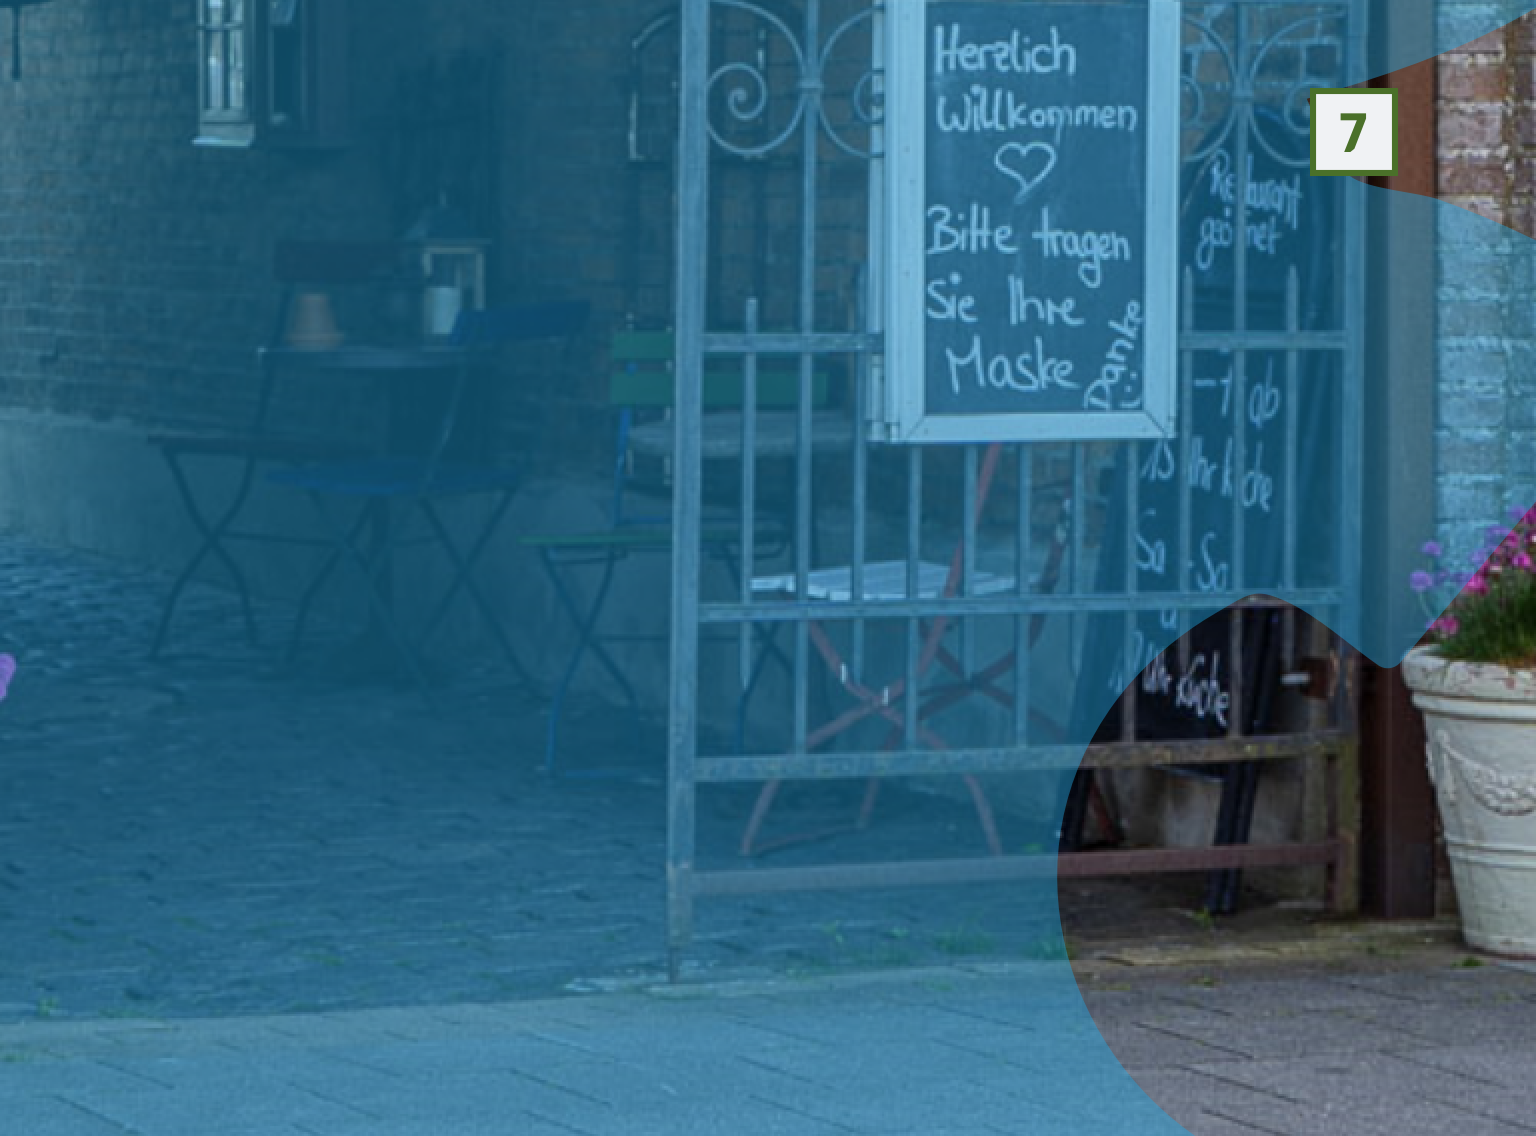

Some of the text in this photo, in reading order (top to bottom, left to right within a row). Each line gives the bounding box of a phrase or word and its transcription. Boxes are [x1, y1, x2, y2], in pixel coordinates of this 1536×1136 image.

[933, 22, 1077, 74] Herzlich
[935, 84, 1138, 148] Willkommen
[925, 203, 1130, 288] Bitte tragen
[925, 272, 1085, 325] Sie Ihre
[945, 336, 1081, 394] Maske
[1083, 299, 1143, 411] Danke
